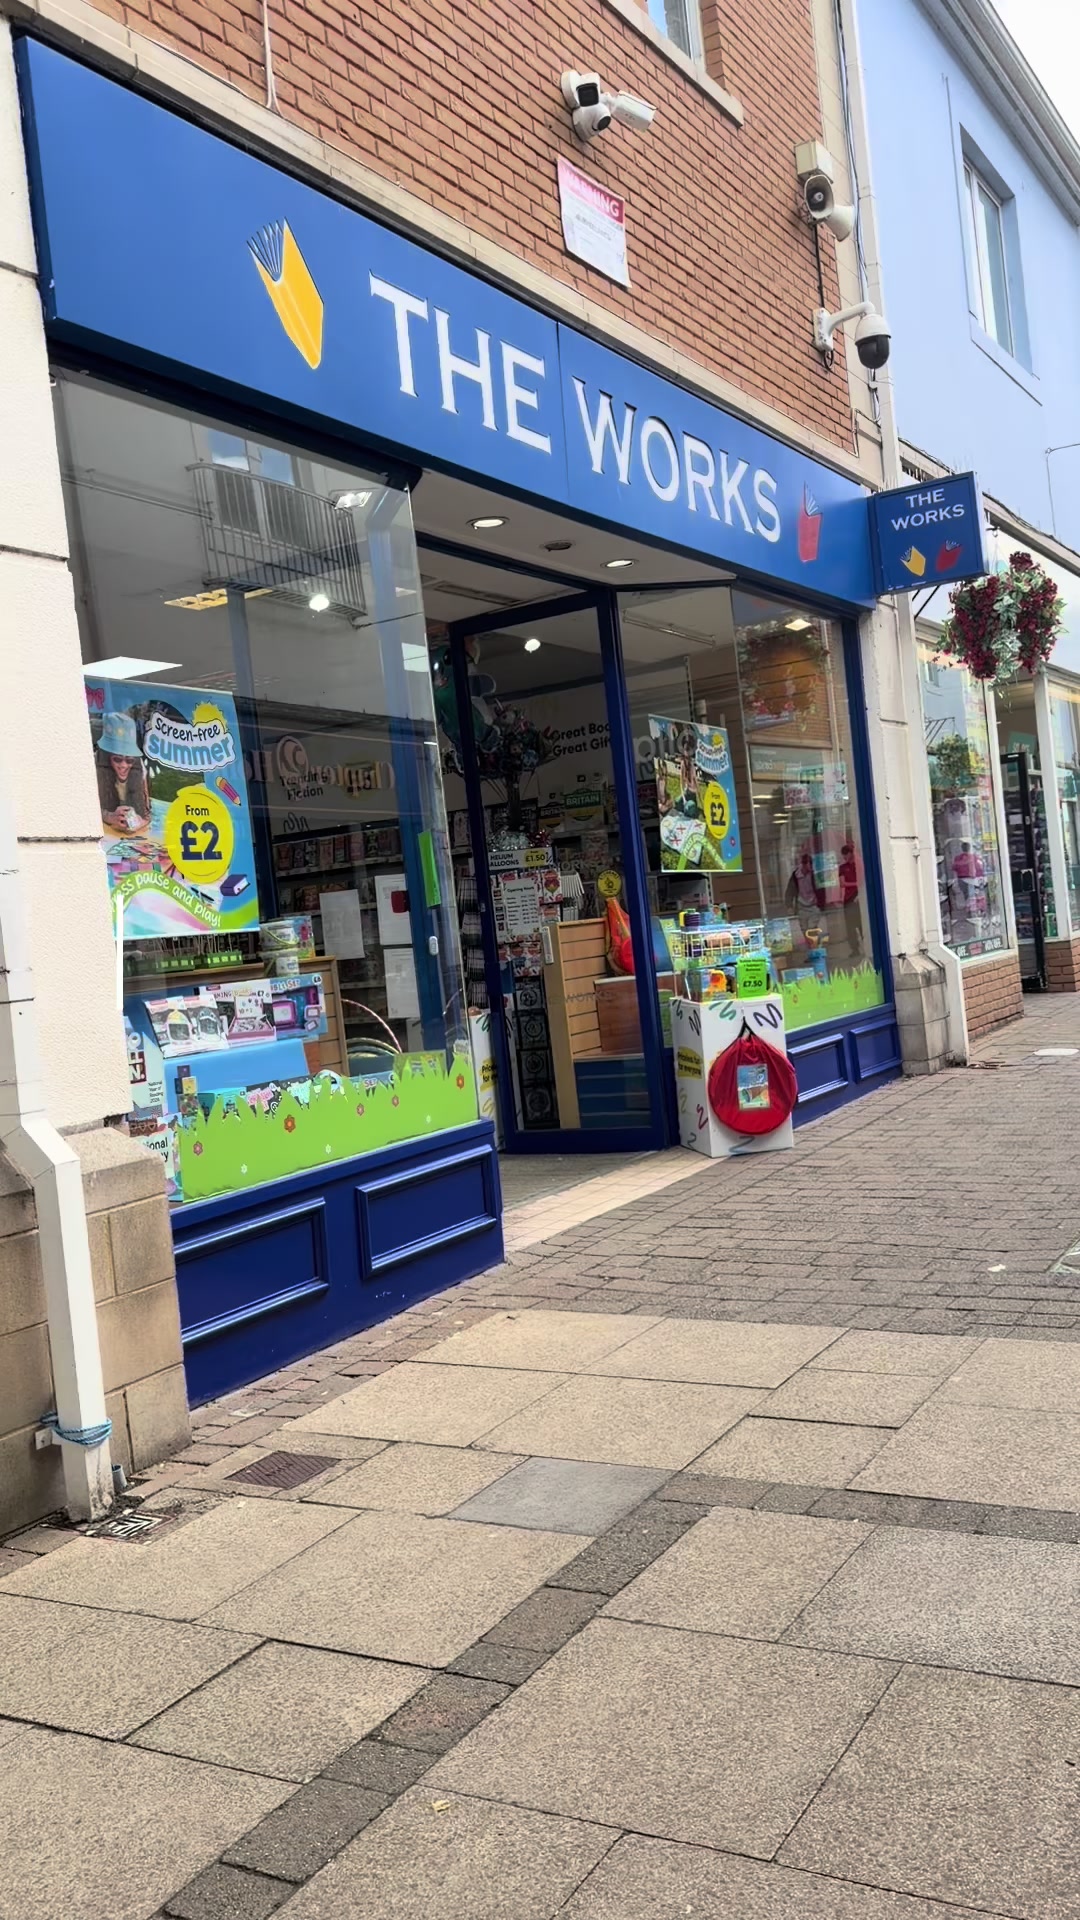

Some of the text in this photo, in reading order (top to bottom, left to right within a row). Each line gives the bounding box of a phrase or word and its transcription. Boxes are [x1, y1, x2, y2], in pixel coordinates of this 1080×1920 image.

[369, 270, 781, 543] THE WORKS
[905, 488, 945, 508] THE
[891, 504, 965, 531] WORKS
[155, 717, 221, 742] Screen-free
[551, 723, 610, 741] Great Boo
[148, 735, 232, 766] summer
[553, 738, 611, 757] Great Gif
[287, 786, 324, 801] Fiction
[566, 795, 599, 806] BRITAIN
[185, 805, 210, 816] From
[710, 802, 726, 827] £2
[180, 820, 222, 860] £2
[525, 854, 545, 862] £1.50
[135, 870, 170, 891] pause
[173, 884, 194, 908] and
[194, 903, 221, 928] play!
[743, 979, 763, 988] £7.50
